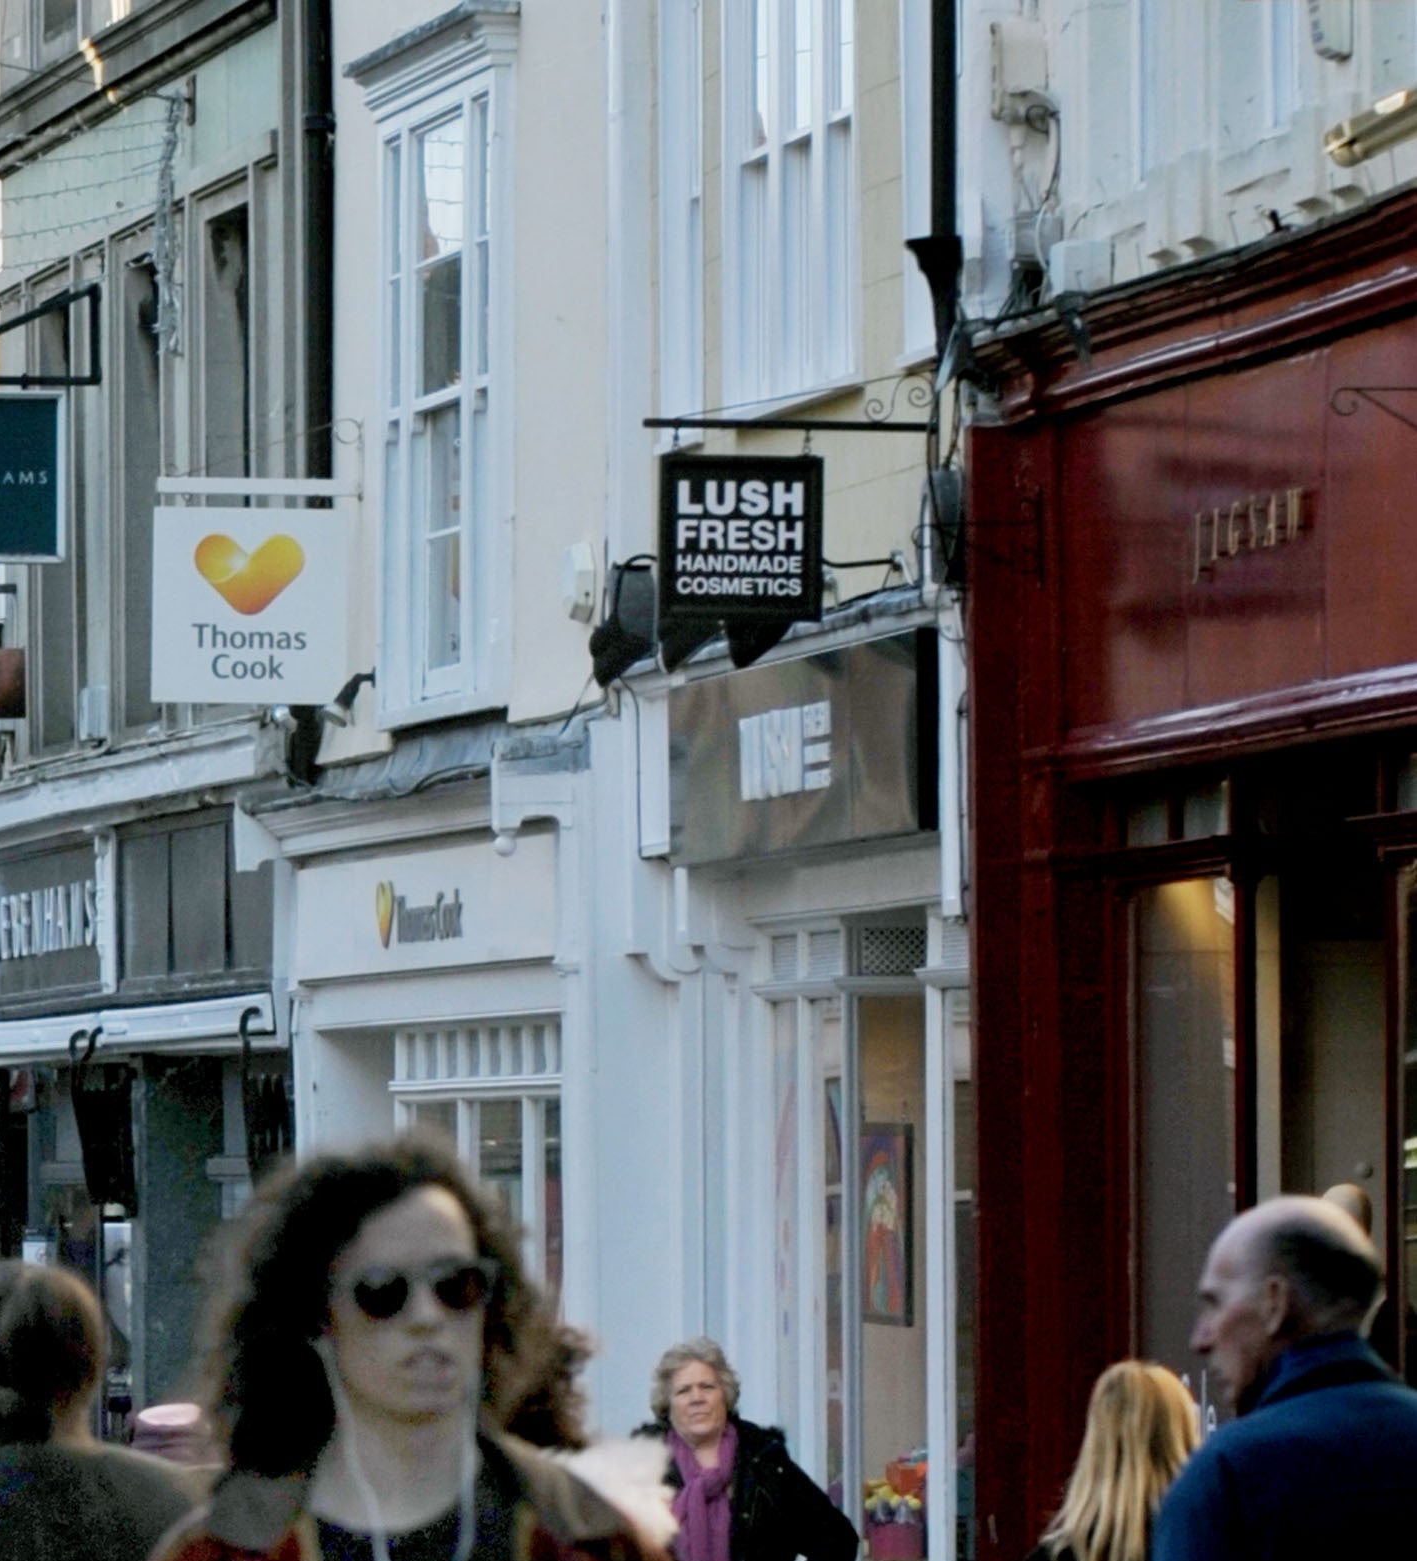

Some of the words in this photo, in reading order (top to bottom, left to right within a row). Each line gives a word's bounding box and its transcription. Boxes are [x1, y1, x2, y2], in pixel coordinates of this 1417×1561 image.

[677, 480, 804, 516] LUSH
[677, 520, 804, 551] FRESH
[676, 554, 803, 573] HANDMADE
[676, 577, 802, 596] COSMETICS
[192, 624, 307, 650] Thomas
[212, 654, 284, 680] Cook
